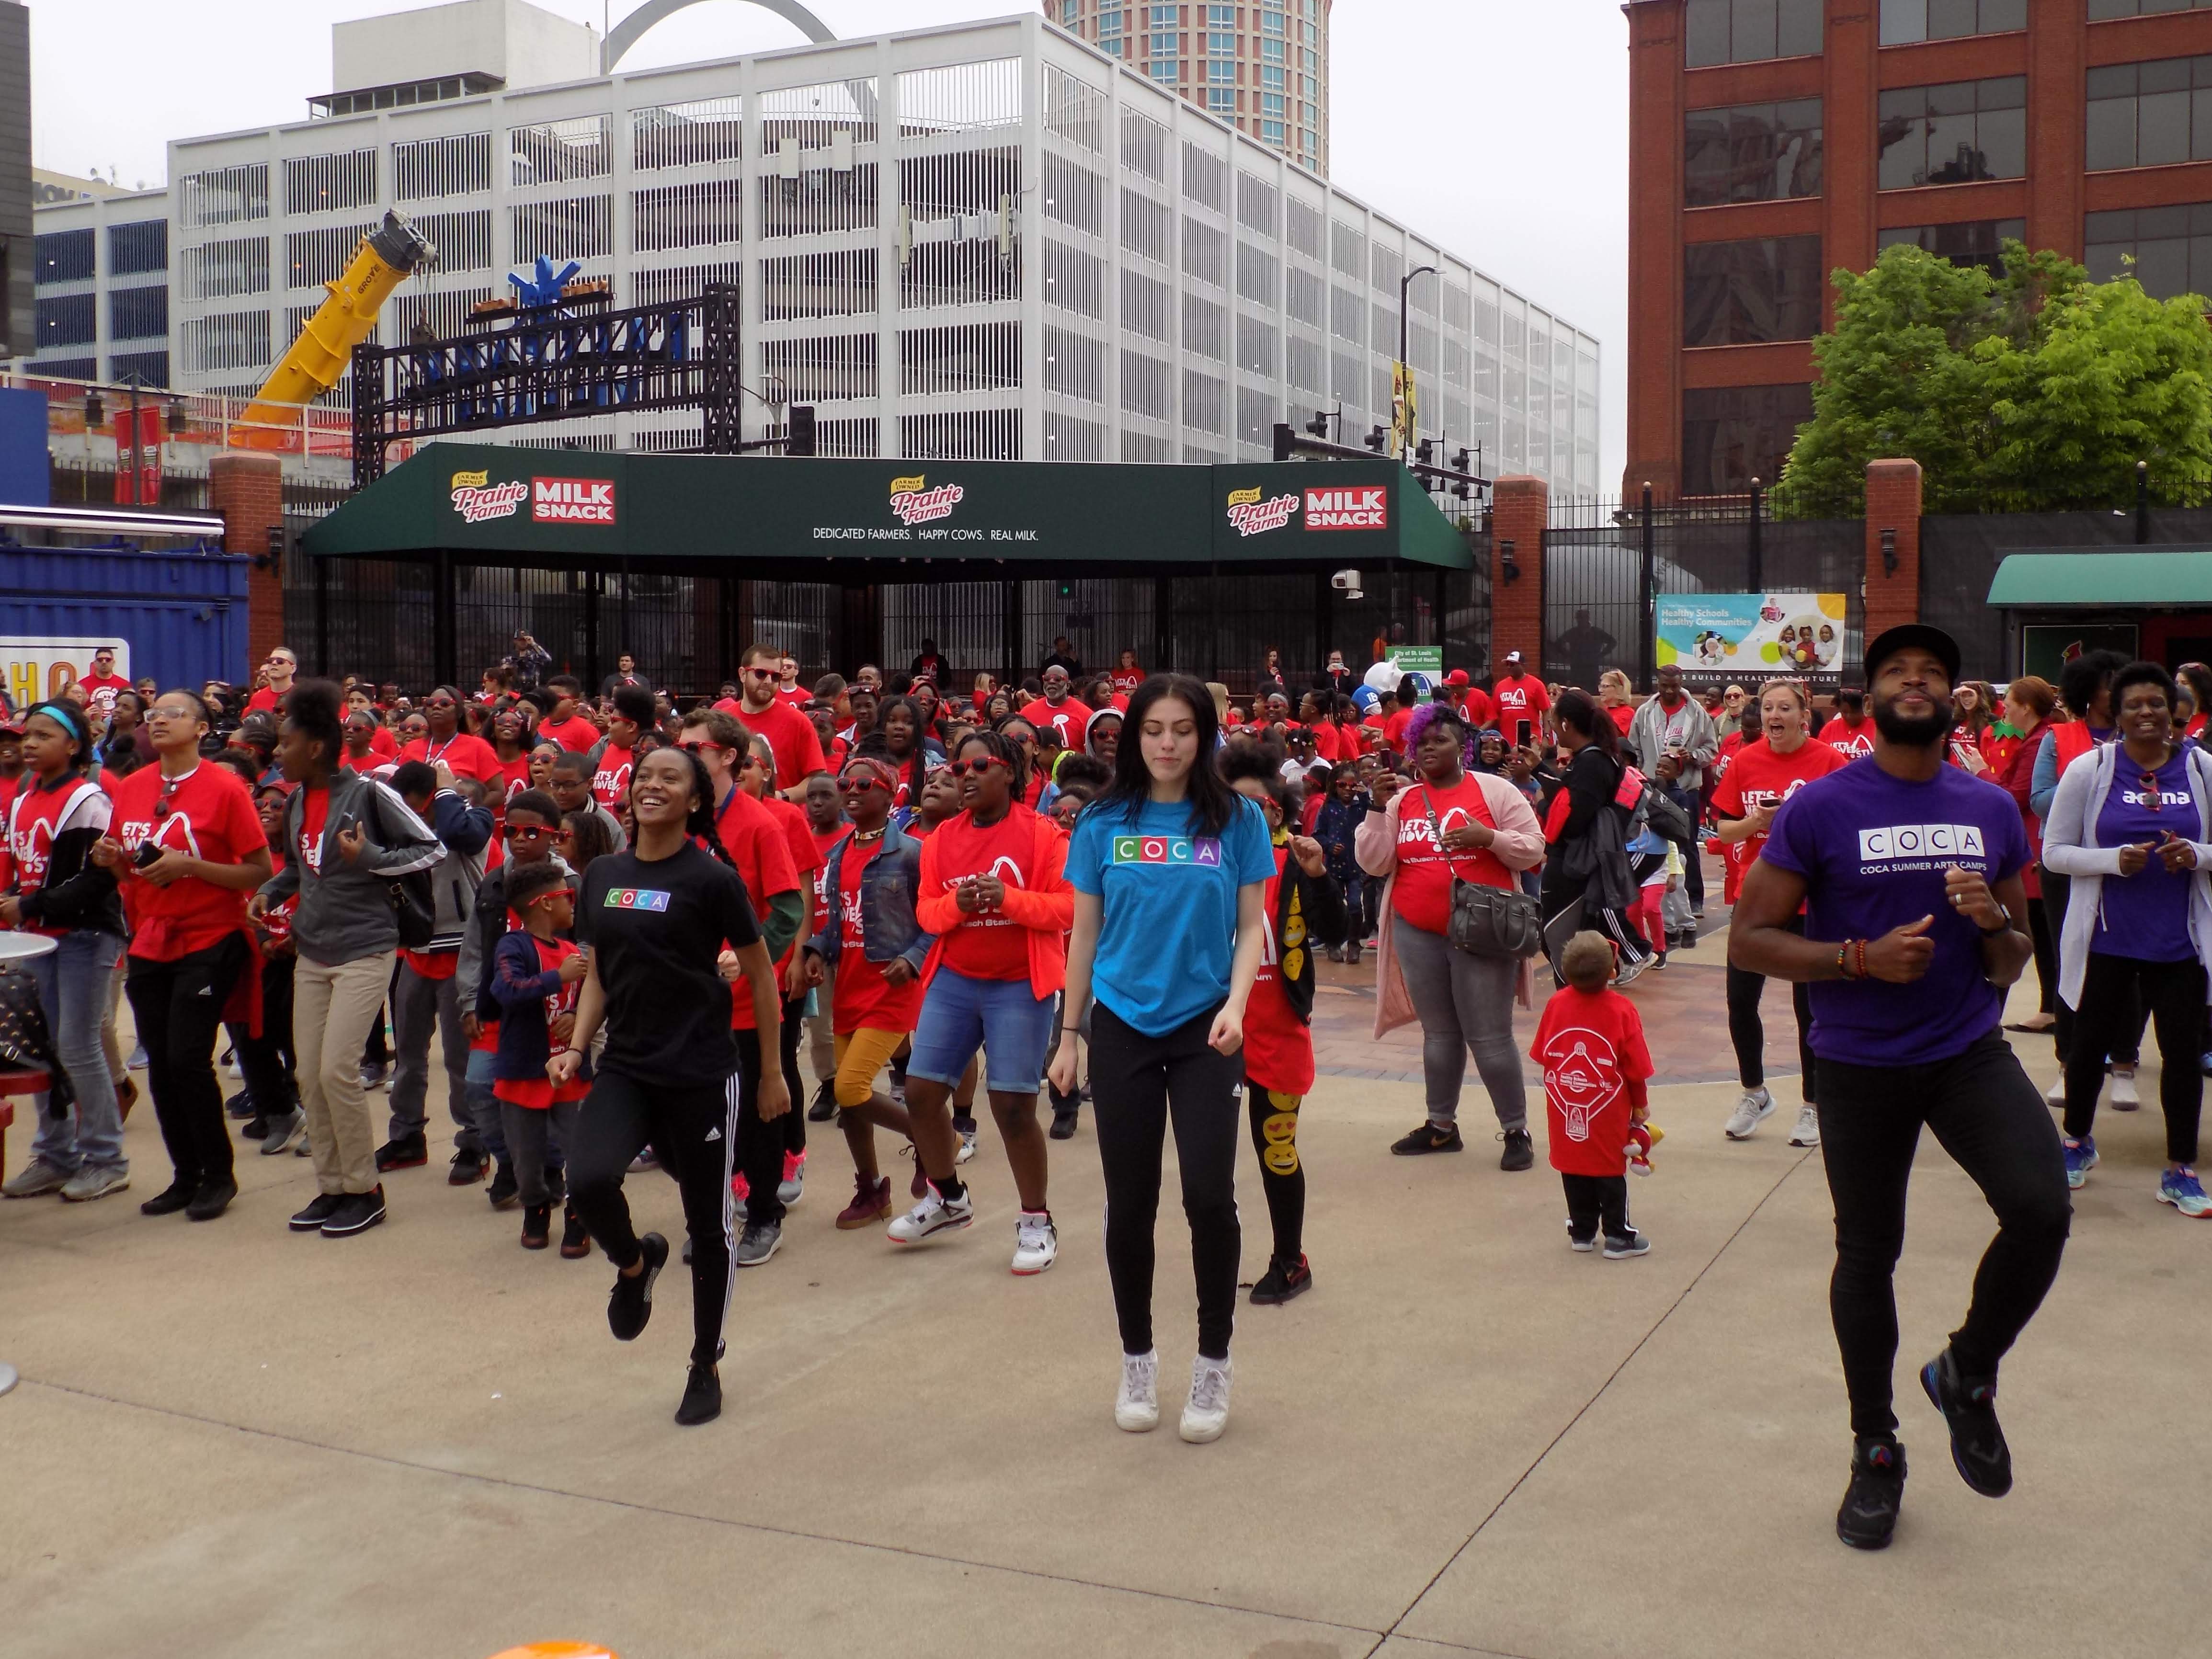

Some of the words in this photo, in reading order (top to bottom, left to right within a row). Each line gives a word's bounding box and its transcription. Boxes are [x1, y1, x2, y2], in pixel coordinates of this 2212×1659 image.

[357, 264, 381, 294] GROVE
[452, 482, 527, 510] Prairie
[536, 482, 612, 504] MILK
[891, 485, 962, 513] Prairie
[1307, 491, 1384, 511] MILK
[464, 503, 516, 522] Farms
[536, 504, 613, 520] SNACK
[902, 504, 951, 525] Farms
[1228, 494, 1300, 525] Prairie
[1307, 511, 1384, 526] SNACK
[1240, 514, 1288, 535] Farms
[814, 528, 865, 540] DEDICATED
[867, 529, 913, 540] FARMERS.
[918, 529, 948, 540] HAPPY
[951, 529, 985, 541] COWS.
[990, 530, 1013, 541] REAL
[1015, 530, 1039, 541] MILK.
[1662, 609, 1694, 618] Healthy
[1696, 609, 1729, 617] Schools
[1662, 618, 1694, 627] Healthy
[1696, 618, 1752, 626] Communities
[1741, 791, 1775, 804] LET'S
[122, 821, 152, 837] ET'S
[1400, 818, 1433, 832] LET'S
[1119, 840, 1215, 862] COCA
[1867, 829, 1980, 854] COCA
[1860, 865, 1890, 875] COCA
[1892, 863, 1931, 871] SUMMER
[1934, 861, 1957, 869] ARTS
[1960, 861, 1987, 871] CAMPS
[609, 891, 663, 909] COCA
